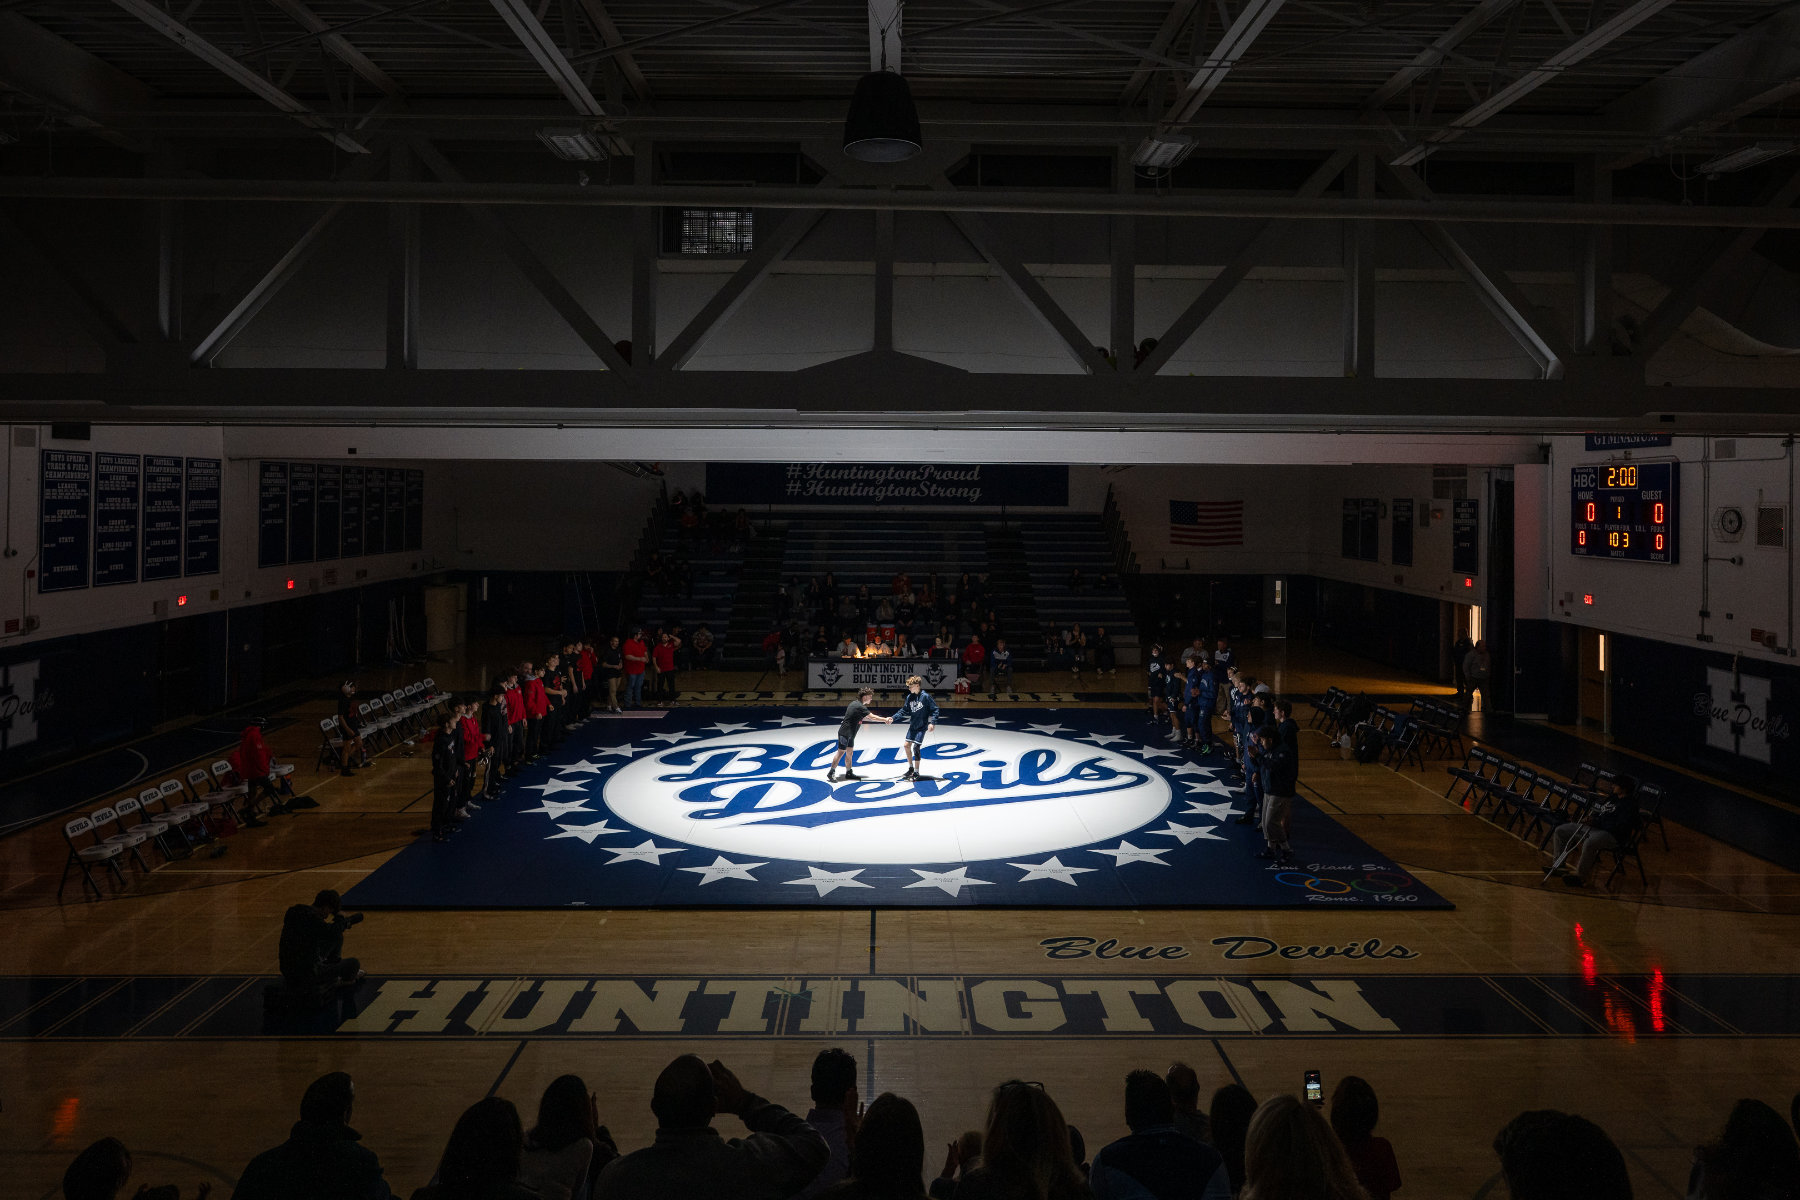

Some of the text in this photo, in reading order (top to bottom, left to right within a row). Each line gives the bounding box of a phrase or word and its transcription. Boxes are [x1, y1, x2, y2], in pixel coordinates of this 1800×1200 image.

[785, 463, 983, 485] #HuntingtonProud
[1573, 474, 1596, 488] HBC
[1608, 467, 1636, 487] 2:00
[785, 480, 984, 503] #HuntingtonStrong
[1577, 490, 1594, 501] HOME
[1641, 490, 1663, 501] GUEST
[1587, 503, 1595, 522] 0
[1617, 505, 1621, 519] 1
[1654, 503, 1664, 524] 0
[1579, 530, 1586, 545] 0
[1656, 534, 1664, 550] 0
[853, 663, 915, 674] HUNTINGTON
[853, 674, 913, 684] BLUE DEVIL
[1706, 665, 1772, 766] H
[658, 739, 986, 782] Blue
[678, 749, 1140, 822] Devils
[94, 810, 113, 823] DEVILS
[69, 820, 89, 834] DEVILS
[1361, 863, 1391, 871] Sr.
[1373, 894, 1419, 903] 1960
[1041, 936, 1420, 960] Blue Devils
[335, 979, 1402, 1033] HUNTINGTON
